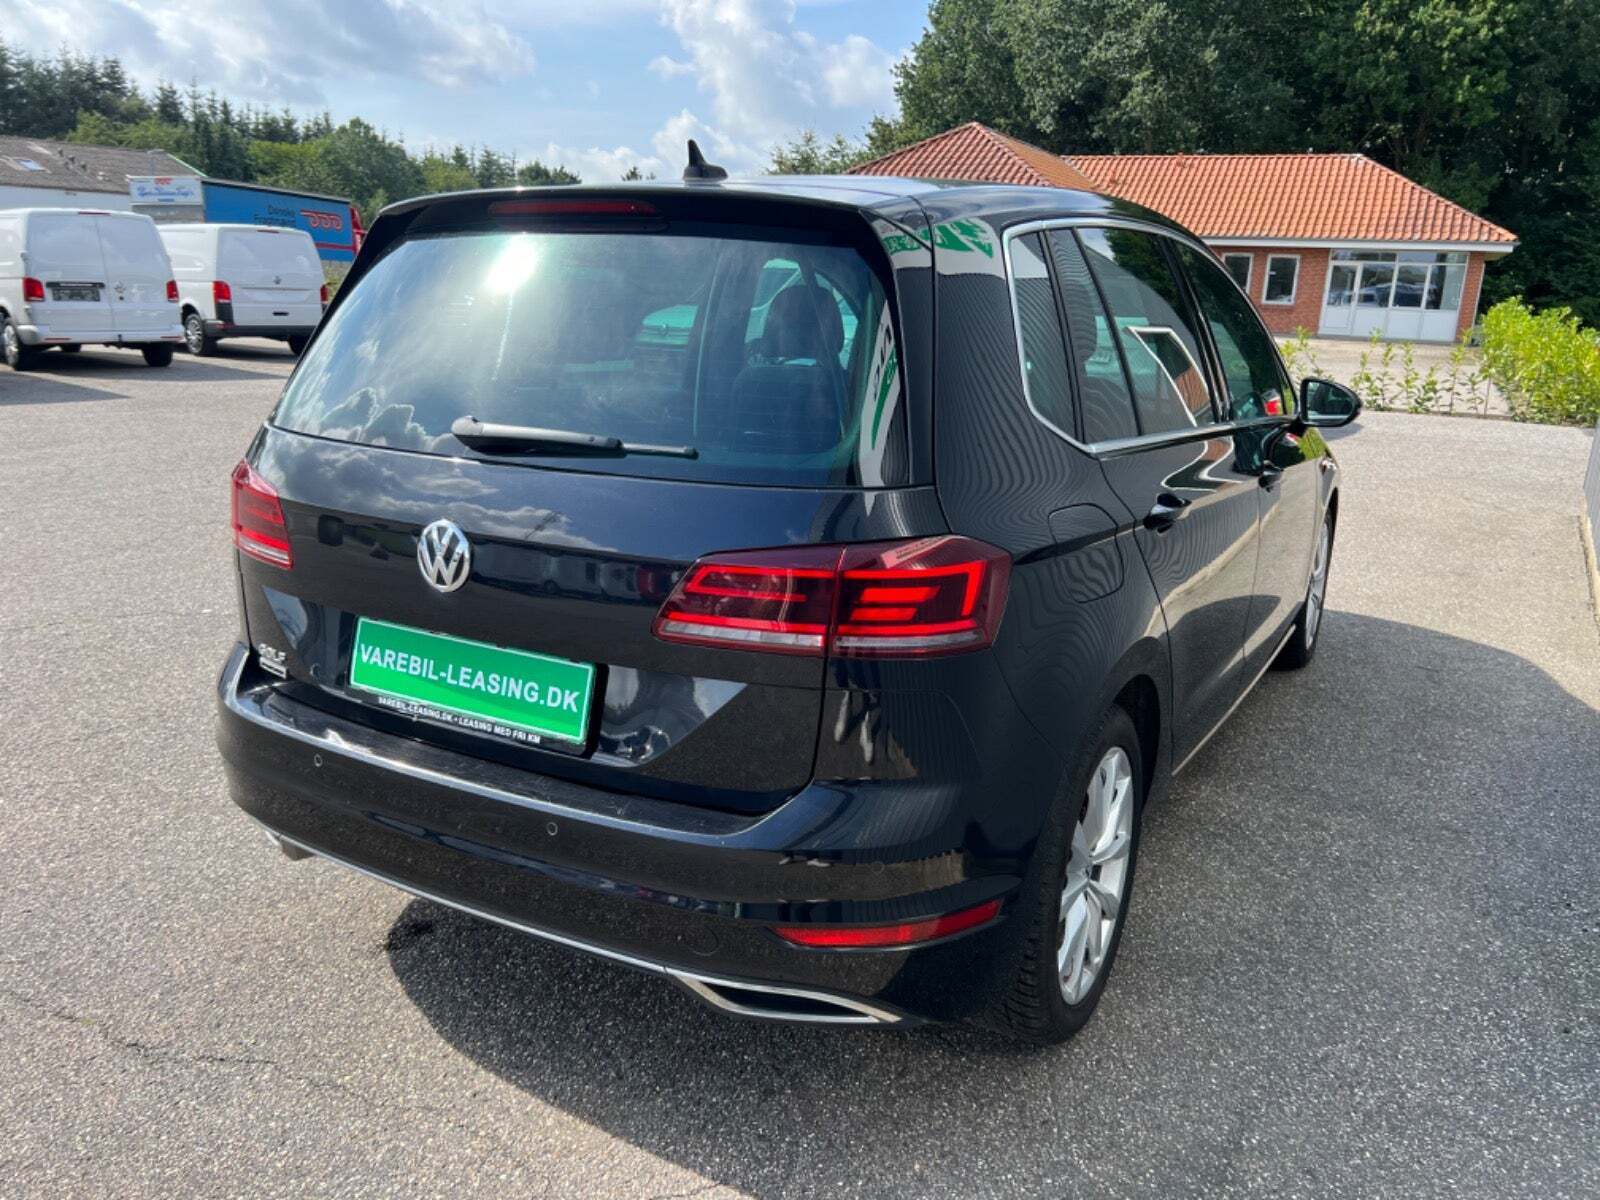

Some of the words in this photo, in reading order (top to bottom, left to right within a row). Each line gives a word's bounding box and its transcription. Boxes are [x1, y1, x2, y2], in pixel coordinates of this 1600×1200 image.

[360, 643, 581, 713] VAREBIL-LEASING.DK
[459, 716, 493, 733] LEASING
[493, 725, 512, 737] MED
[512, 730, 527, 741] FRI
[527, 733, 541, 744] KM
